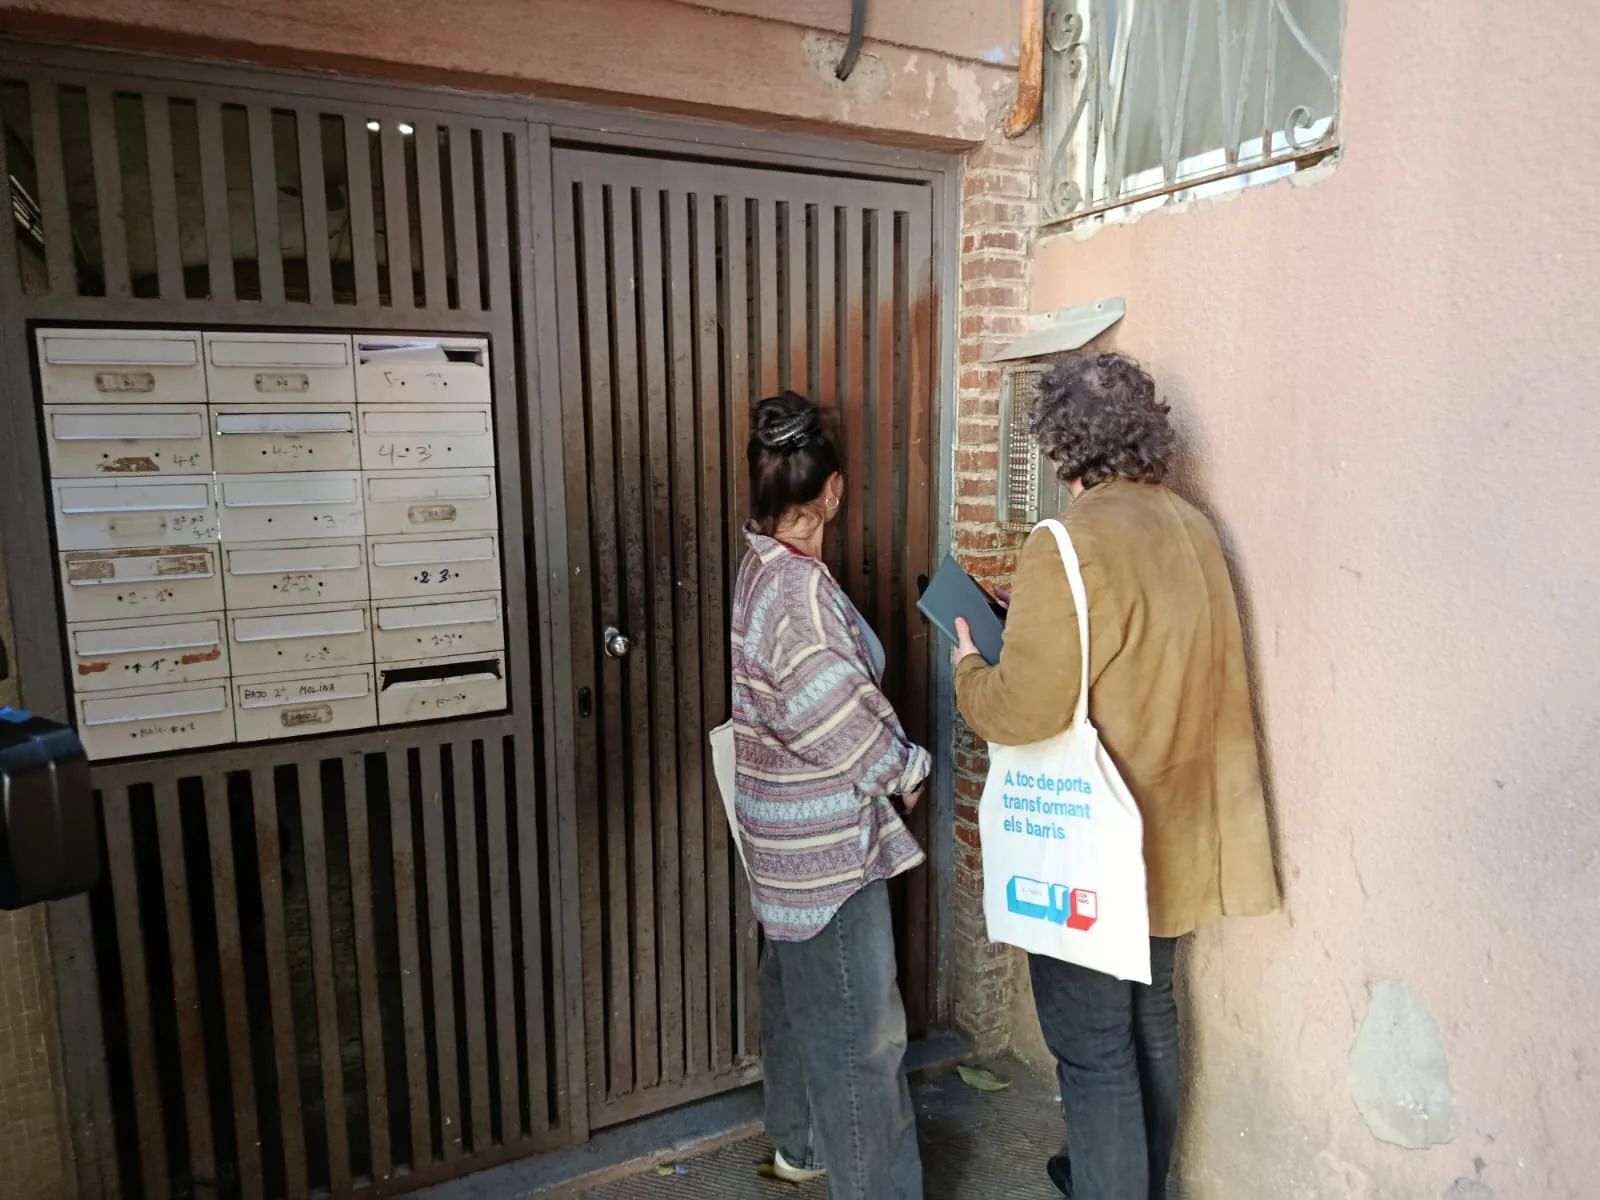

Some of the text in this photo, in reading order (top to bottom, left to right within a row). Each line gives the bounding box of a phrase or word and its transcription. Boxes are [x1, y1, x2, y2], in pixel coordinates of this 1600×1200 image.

[1004, 769, 1092, 795] A toc de porta
[1003, 793, 1092, 819] transformant
[1003, 816, 1065, 840] els barris
